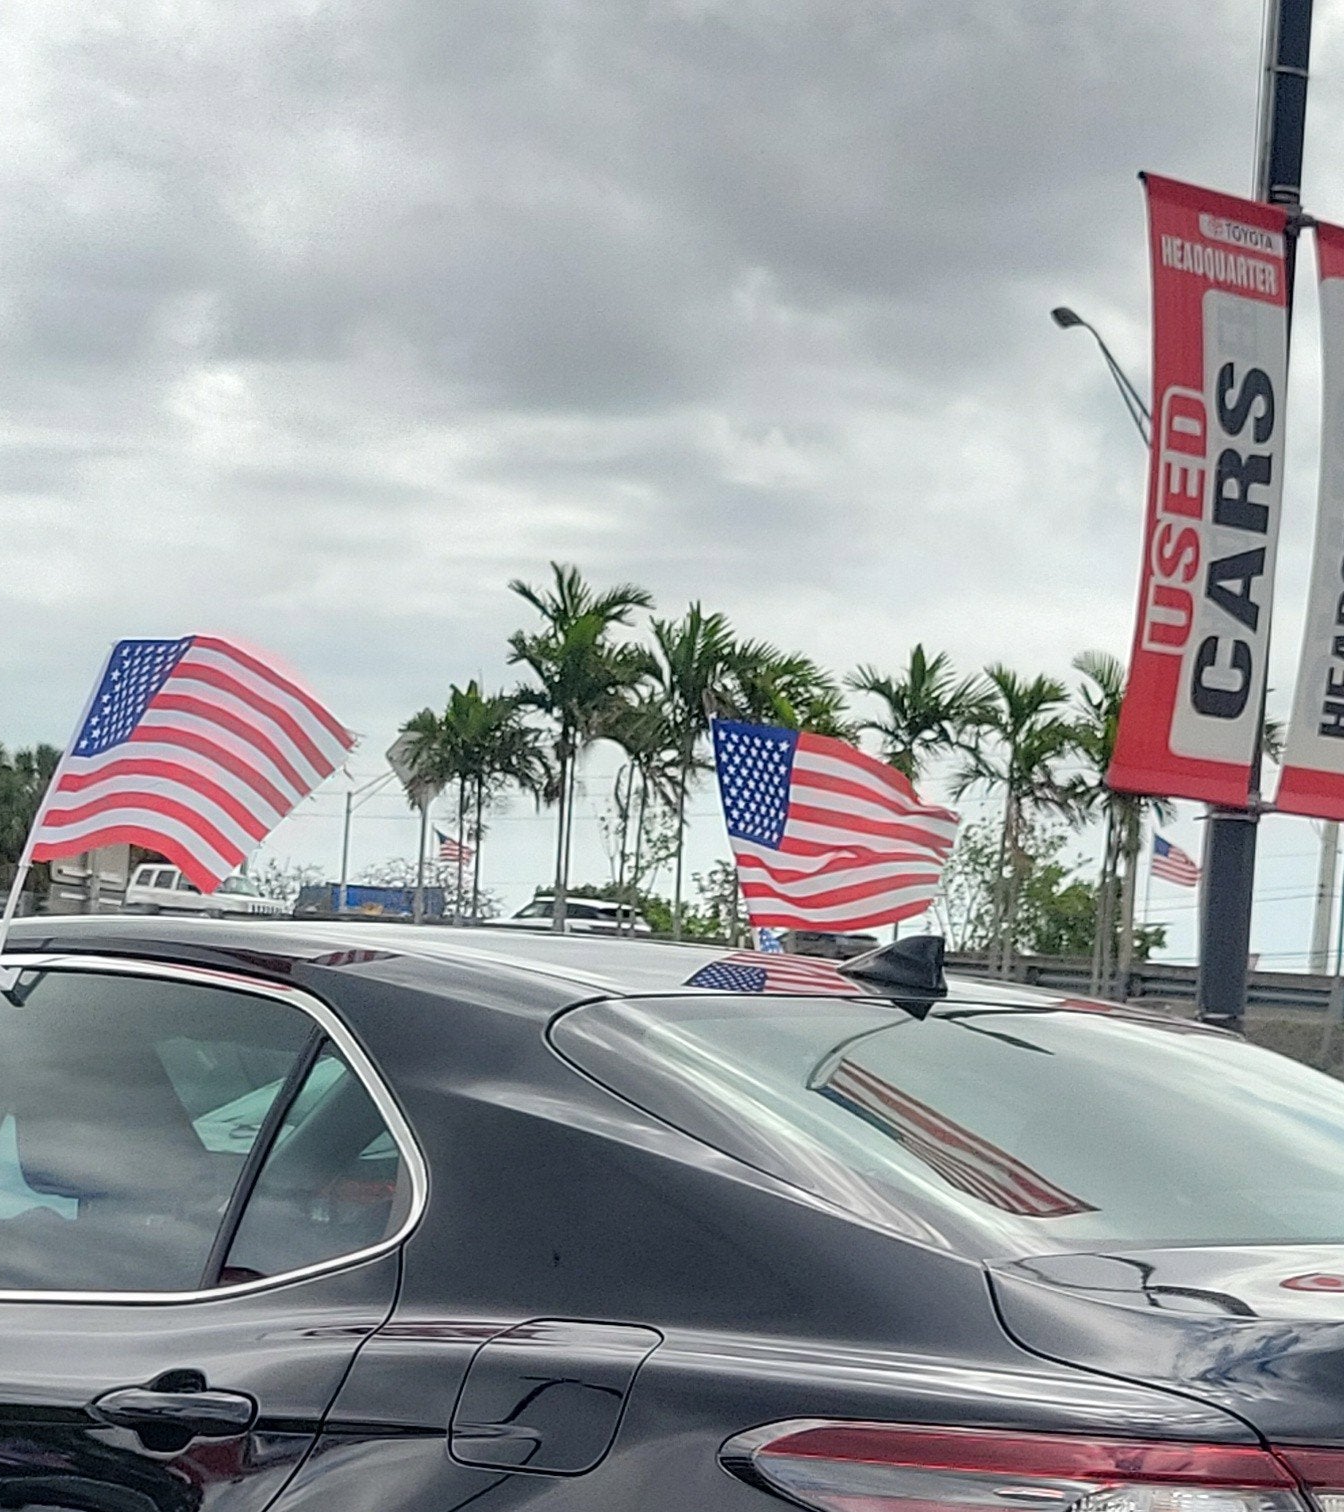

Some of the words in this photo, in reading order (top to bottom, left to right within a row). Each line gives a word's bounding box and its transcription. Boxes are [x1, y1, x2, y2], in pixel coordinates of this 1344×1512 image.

[1160, 233, 1278, 296] HEADQUARTER
[1224, 222, 1274, 250] TOYOTA
[1145, 395, 1208, 650] USED
[1190, 362, 1275, 720] CARS
